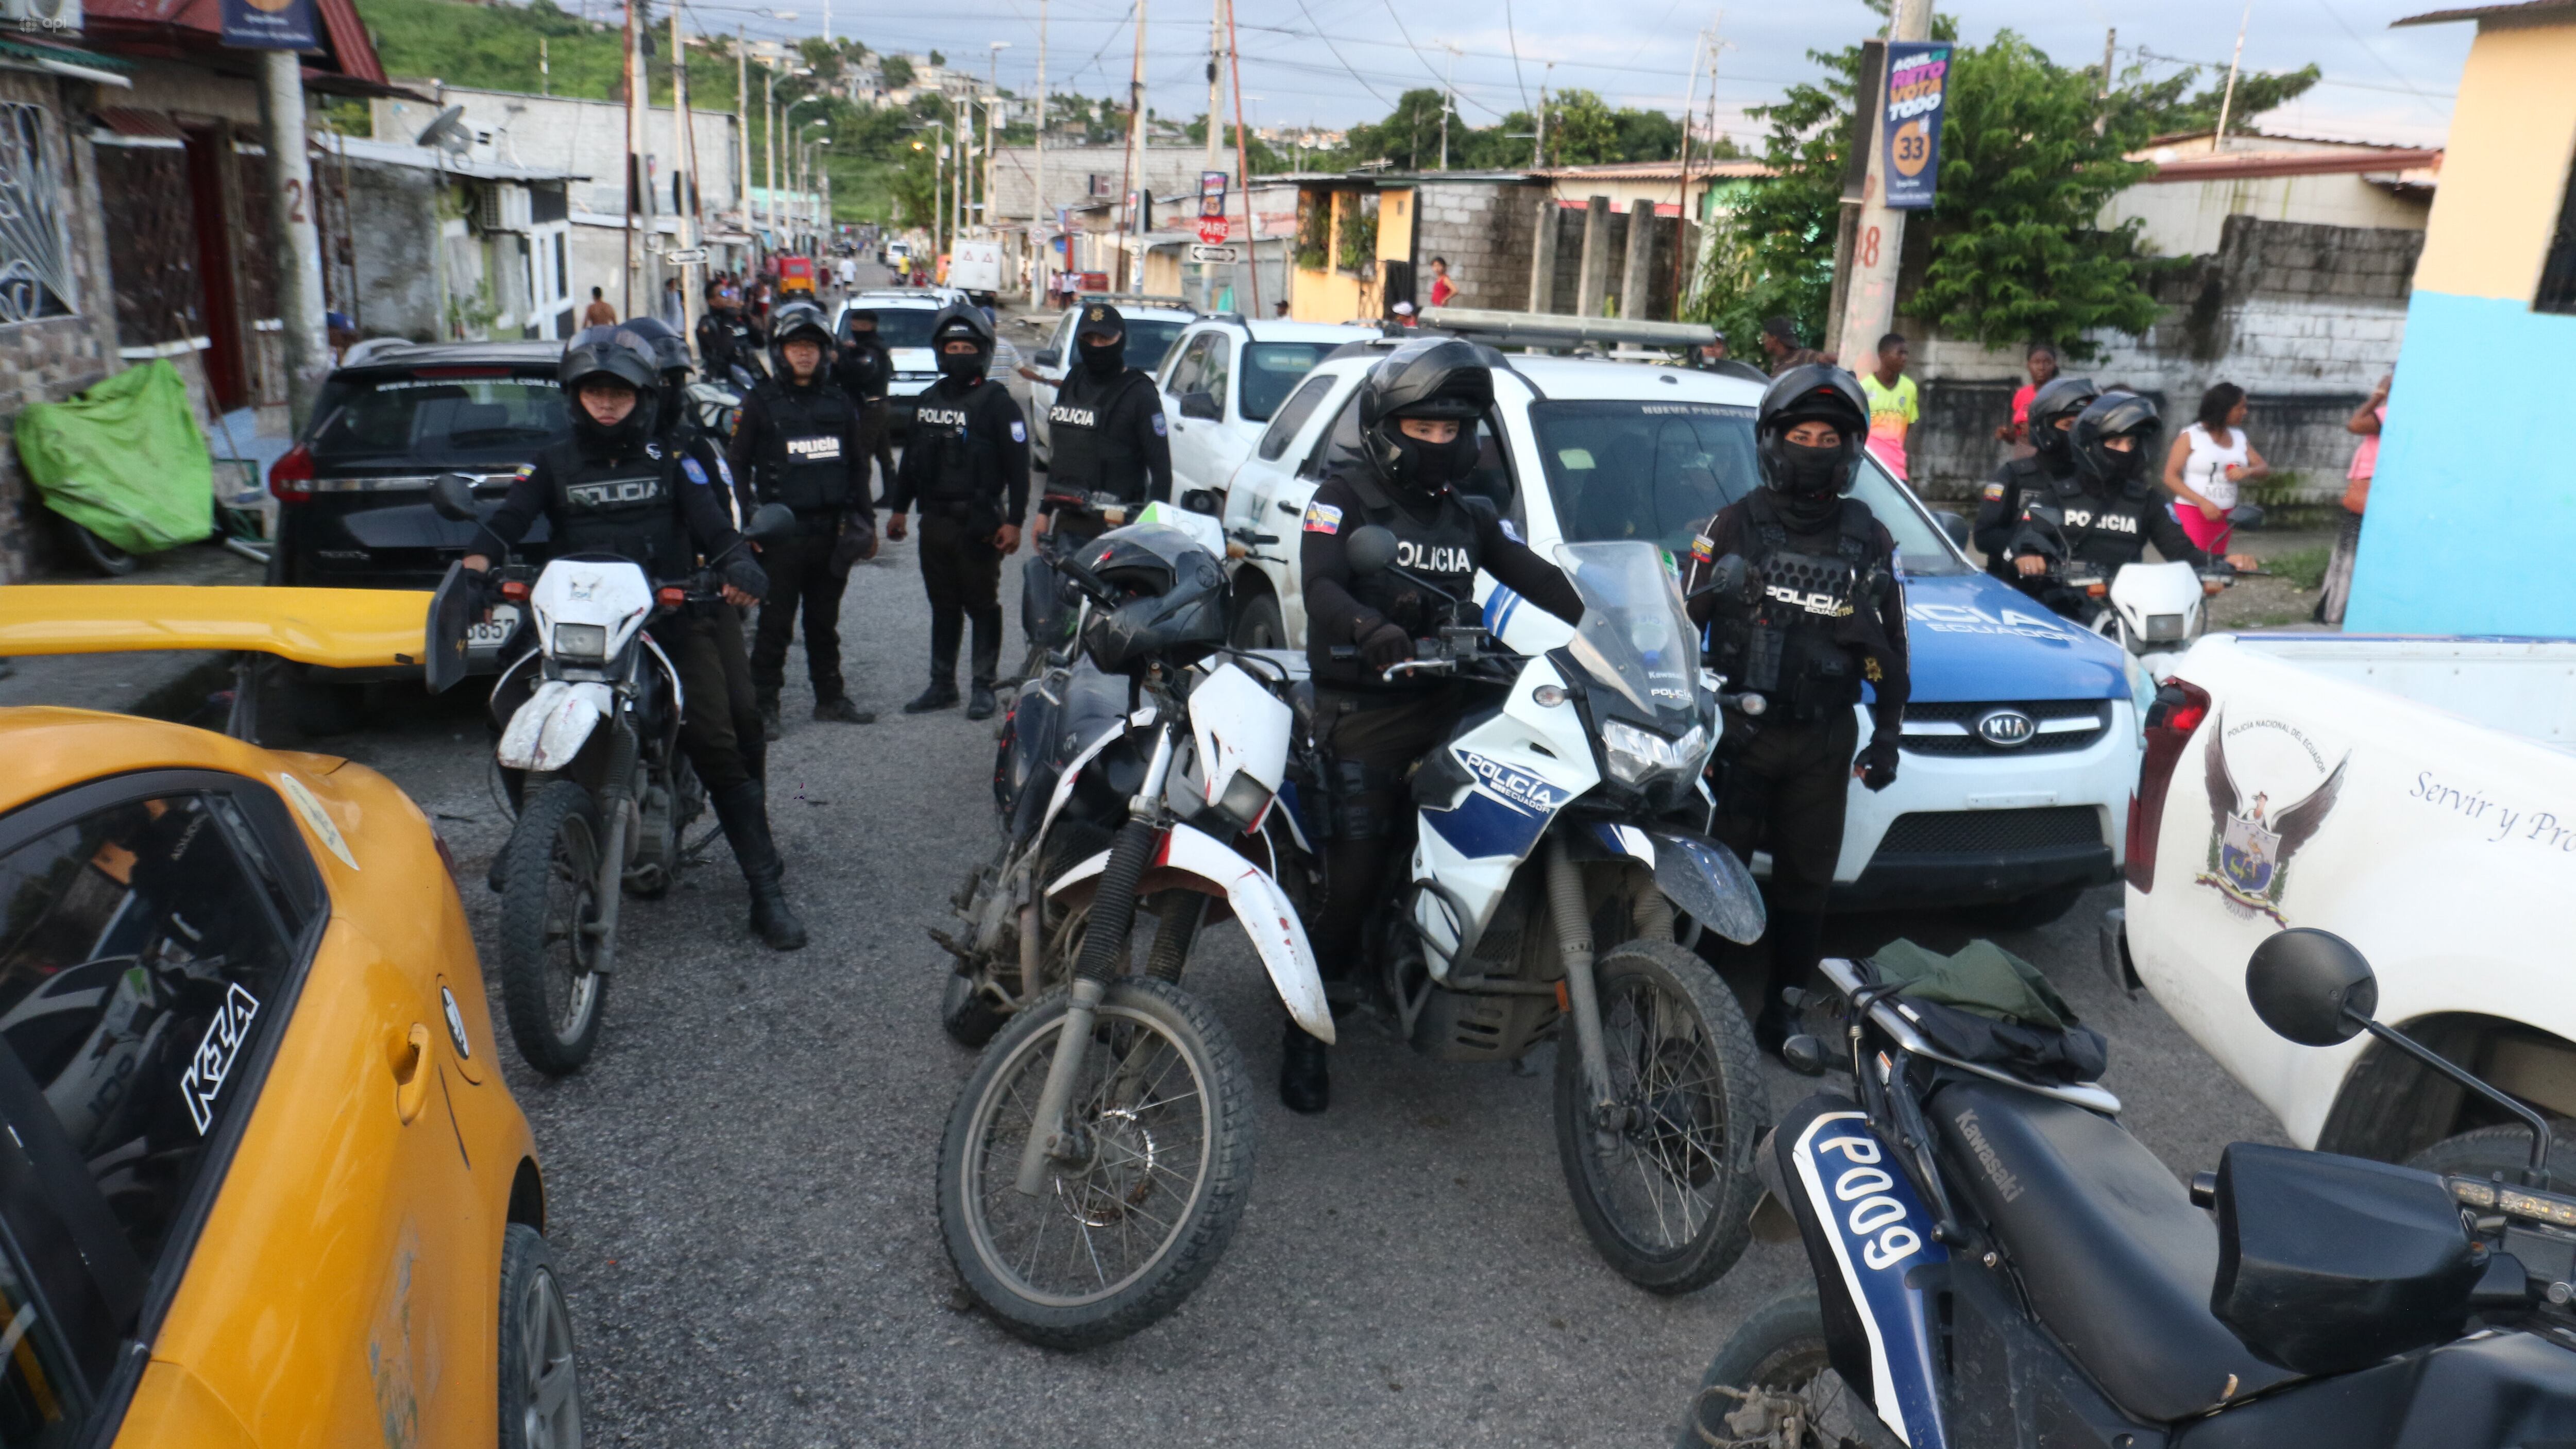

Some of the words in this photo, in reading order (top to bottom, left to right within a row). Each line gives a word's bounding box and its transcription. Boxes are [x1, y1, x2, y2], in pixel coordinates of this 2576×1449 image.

[1890, 77, 1942, 105] VOTA
[1889, 93, 1941, 122] TODO
[1900, 137, 1924, 159] 33
[1199, 220, 1228, 236] PARE
[918, 407, 966, 425] POLICIA
[1049, 405, 1094, 427] POLICIA
[1641, 406, 1690, 415] NUEVA
[1397, 541, 1472, 573] OLICIA
[1804, 606, 1837, 618] ECUAD
[1926, 623, 2084, 643] ECUADOR
[1989, 719, 2026, 737] KIA
[2256, 721, 2289, 734] NACIONAL
[2291, 728, 2302, 742] DEL
[2302, 738, 2326, 774] ECUADOR
[1467, 753, 1551, 805] POLICÍA
[1505, 791, 1550, 814] ECUADOR
[2486, 809, 2519, 842] y
[1955, 1108, 2025, 1203] Kawasaki
[1819, 1136, 1921, 1271] P009
